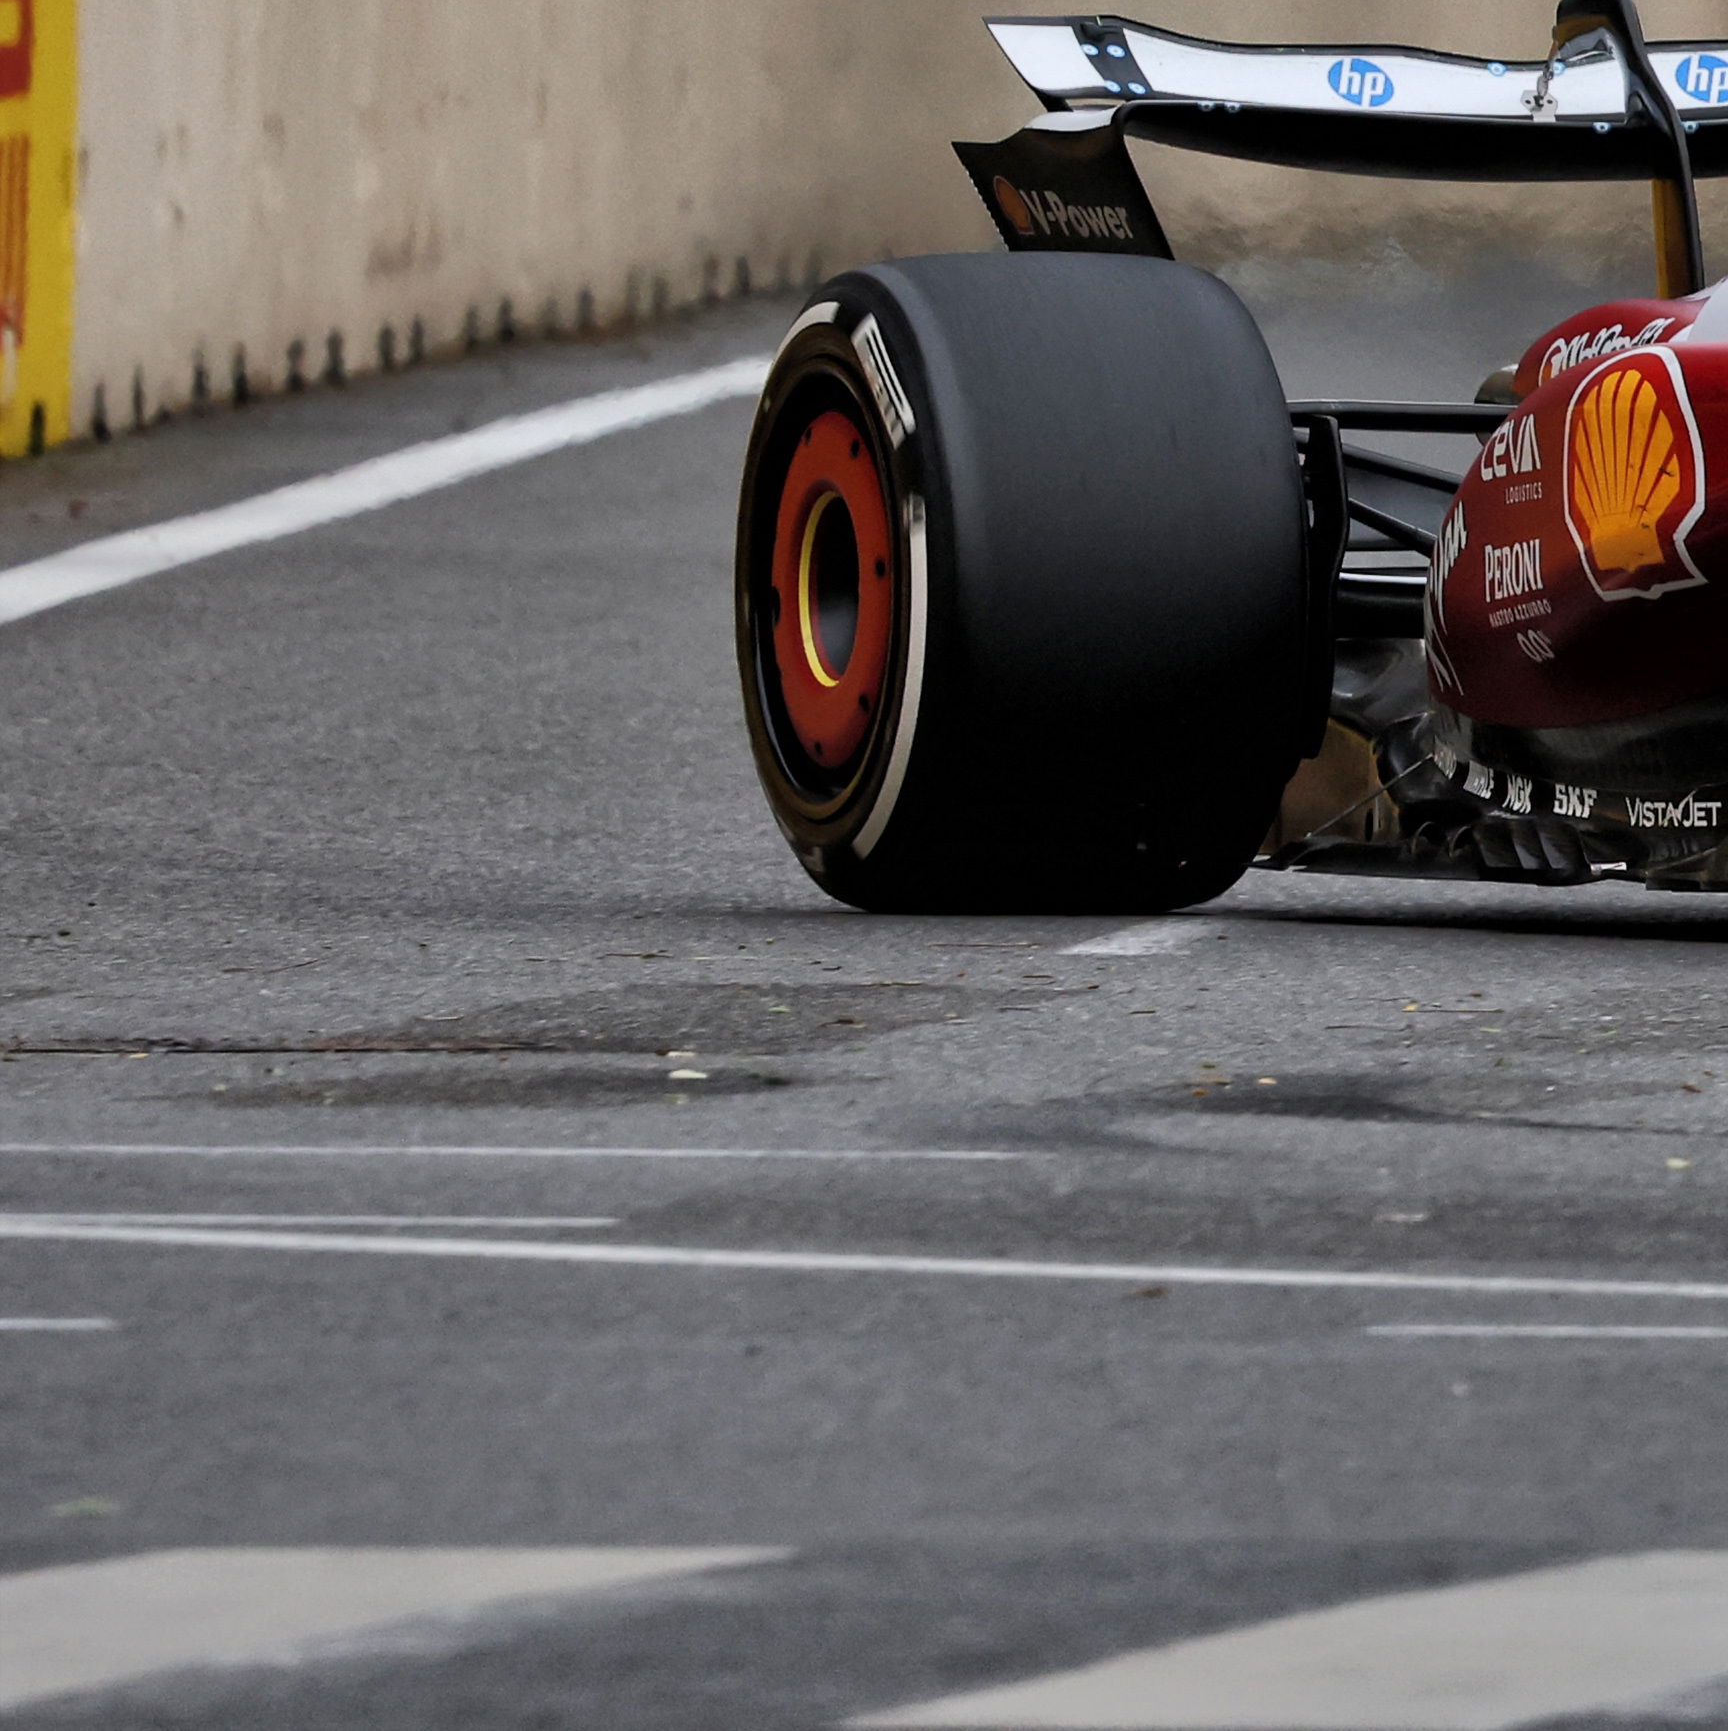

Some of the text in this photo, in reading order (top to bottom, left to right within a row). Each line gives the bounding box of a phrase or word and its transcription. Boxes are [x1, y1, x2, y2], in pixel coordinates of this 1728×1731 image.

[1336, 57, 1384, 107] hp
[1018, 189, 1134, 239] V-Power
[1505, 482, 1543, 504] LOGISTICS
[1484, 539, 1544, 603] PERONI
[1553, 783, 1598, 818] SKF
